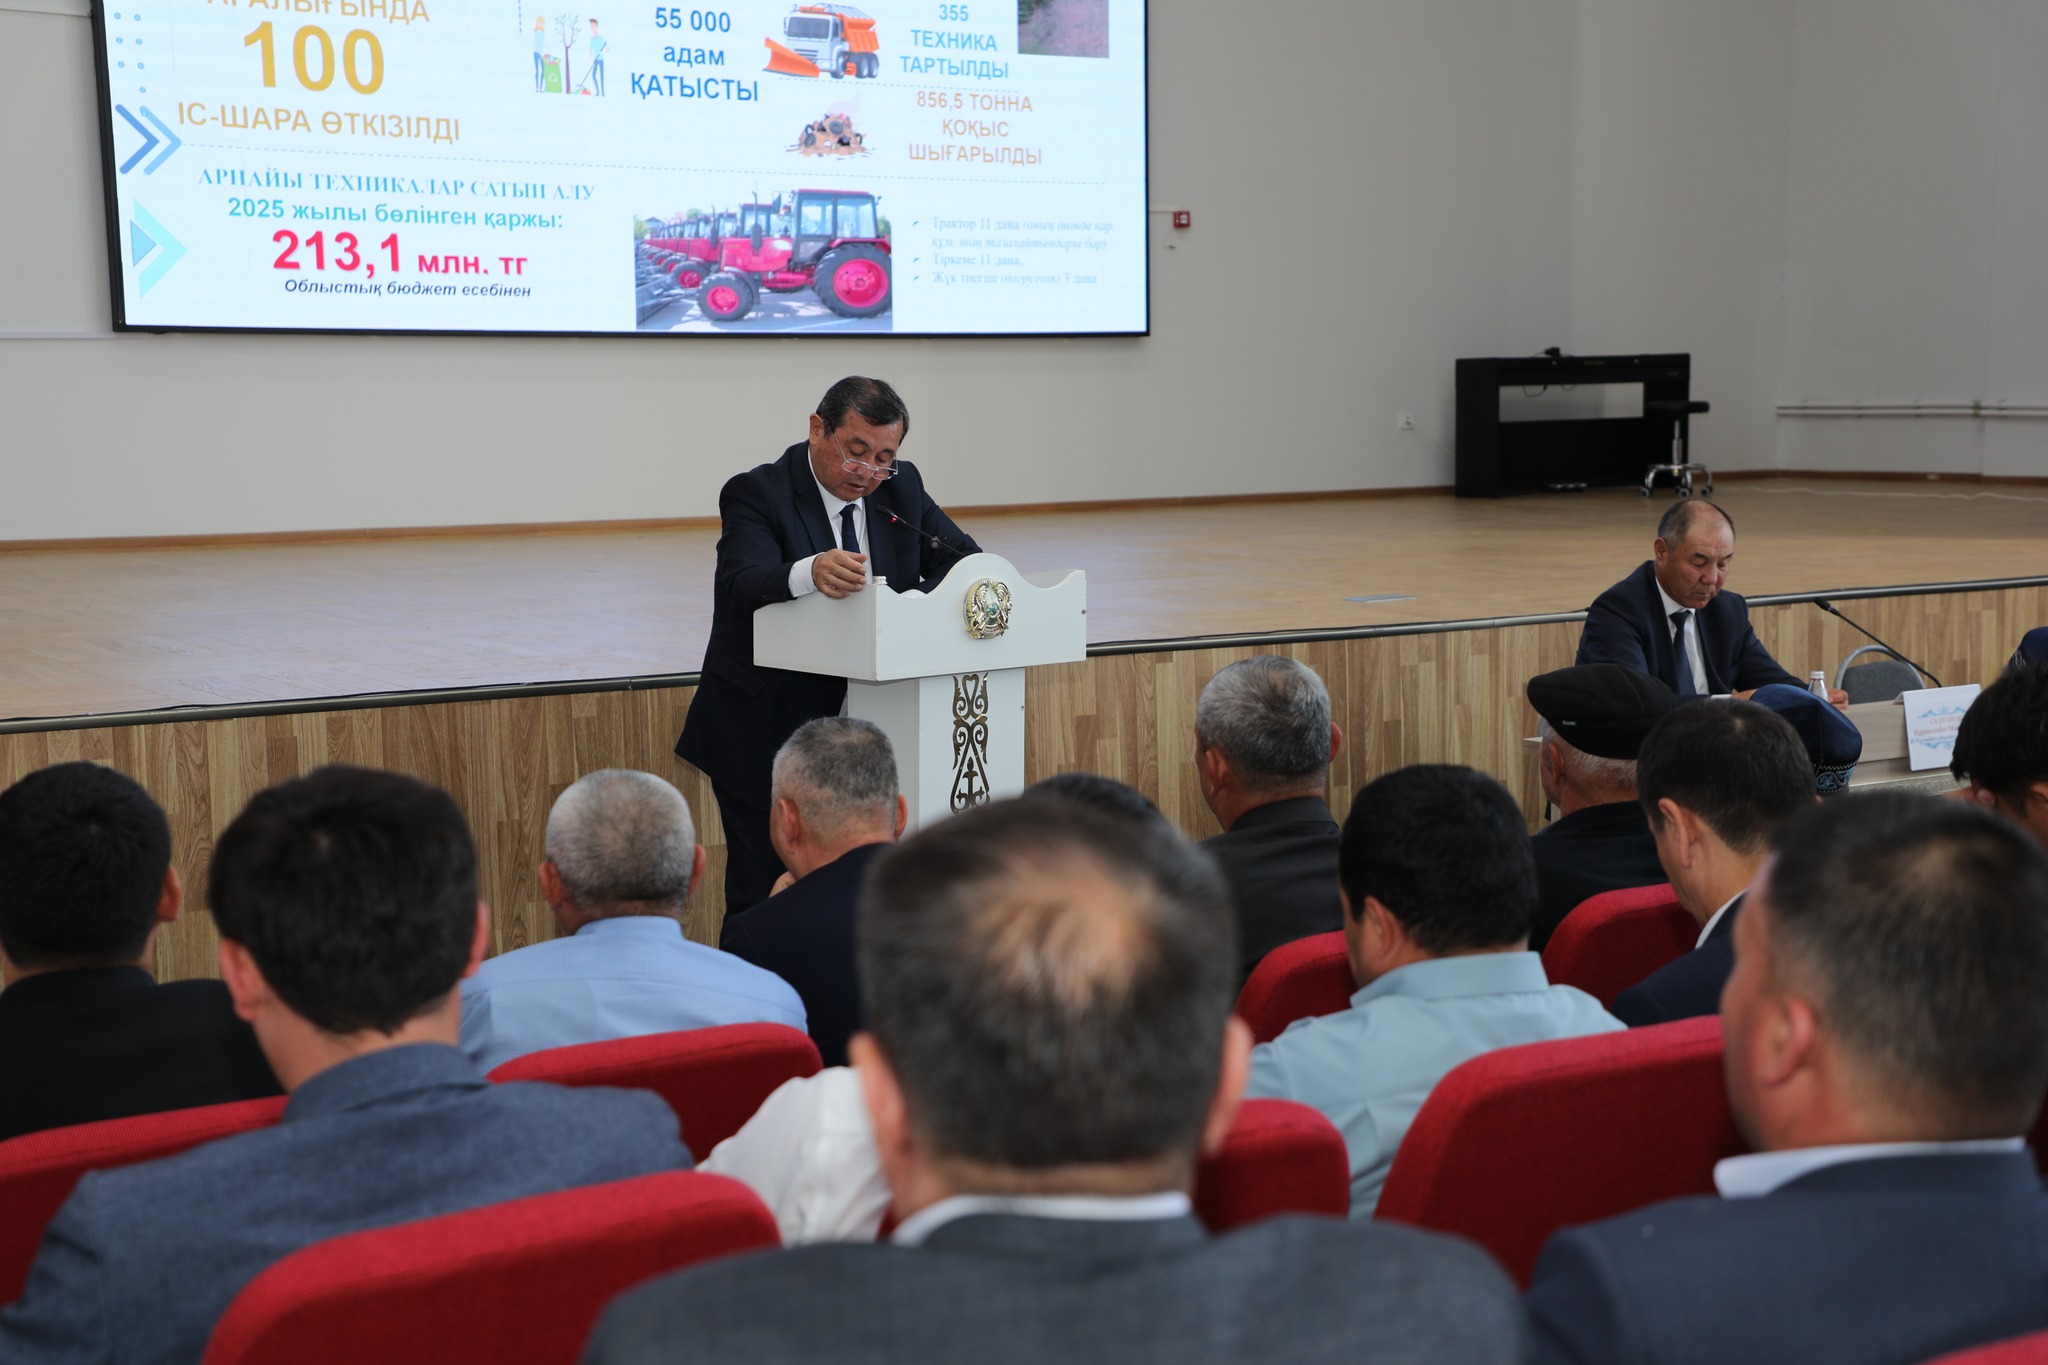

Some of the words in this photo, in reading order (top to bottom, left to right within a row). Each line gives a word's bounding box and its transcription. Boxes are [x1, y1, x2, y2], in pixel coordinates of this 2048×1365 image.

[207, 0, 430, 25] ЫҒЫНДА
[656, 7, 682, 29] 55
[691, 10, 730, 32] 000
[939, 4, 969, 22] 355
[911, 29, 998, 51] ТЕХНИКА
[243, 20, 385, 94] 100
[664, 46, 724, 68] адам
[900, 56, 1008, 80] ТАРТЫЛДЫ
[632, 73, 758, 101] ҚАТЫСТЫ
[917, 90, 963, 112] 856,5
[970, 94, 1032, 112] ТОННА
[179, 102, 311, 132] ІС-ШАРА
[322, 111, 459, 144] ӨТКІЗІЛДІ
[943, 119, 1008, 139] ҚОҚЫС
[910, 144, 1041, 166] ШЫҒАРЫЛДЫ
[199, 167, 303, 189] АРНАЙЫ
[310, 173, 464, 196] ТЕХНИКАЛАР
[470, 180, 546, 199] САТЫП
[553, 184, 596, 200] АЛУ
[228, 198, 284, 218] 2025
[292, 205, 366, 221] жылы
[375, 204, 476, 224] бөлінген
[484, 212, 563, 231] қаржы:
[932, 217, 977, 232] Трактор
[981, 218, 990, 230] 11
[272, 229, 400, 279] 213,1
[418, 255, 488, 274] млн.
[499, 257, 527, 275] тг
[981, 254, 991, 266] 11
[284, 279, 382, 297] Облыстық
[387, 281, 456, 295] бюджет
[461, 283, 532, 297] есебінен
[1064, 273, 1070, 283] 3
